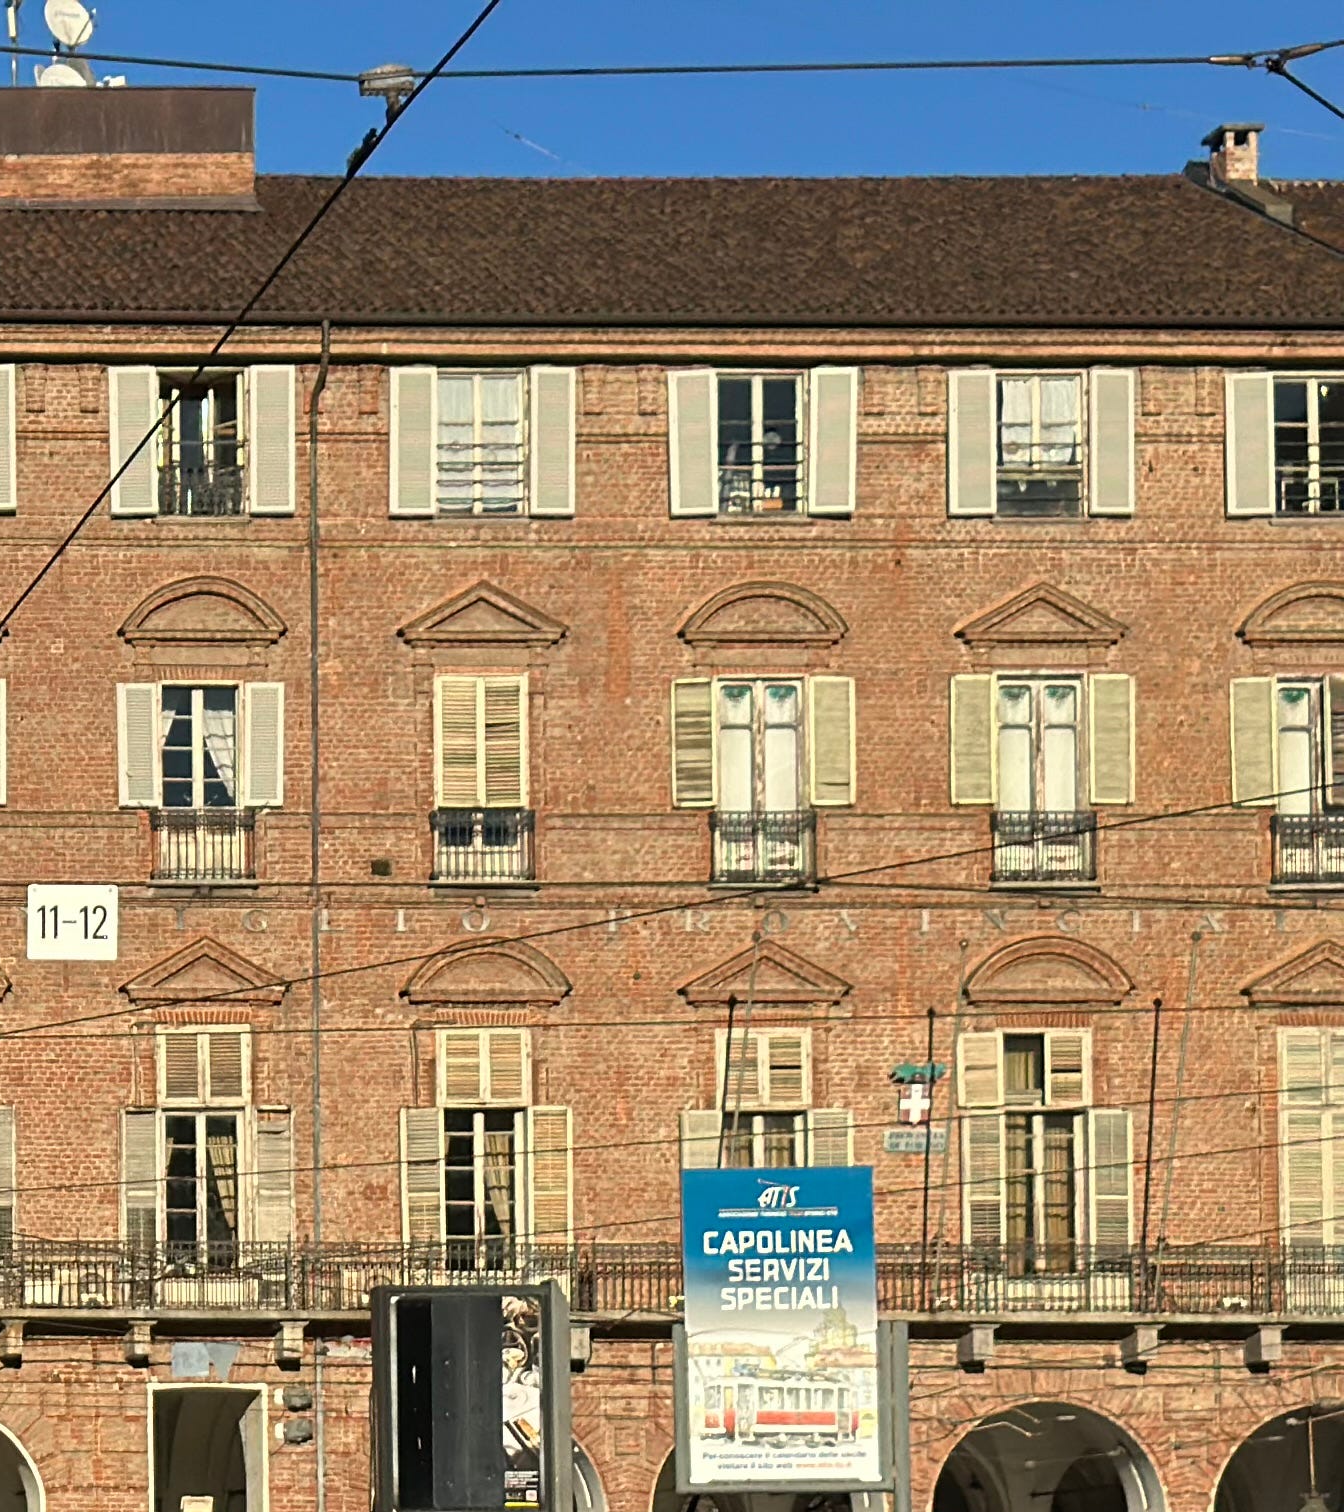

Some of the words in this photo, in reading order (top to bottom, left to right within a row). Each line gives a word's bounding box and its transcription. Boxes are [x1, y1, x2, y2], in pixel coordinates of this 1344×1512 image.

[37, 904, 108, 940] 11-12
[702, 1229, 854, 1255] CAPOLINEA
[728, 1258, 830, 1283] SERVIZI
[720, 1285, 839, 1312] SPECIALI
